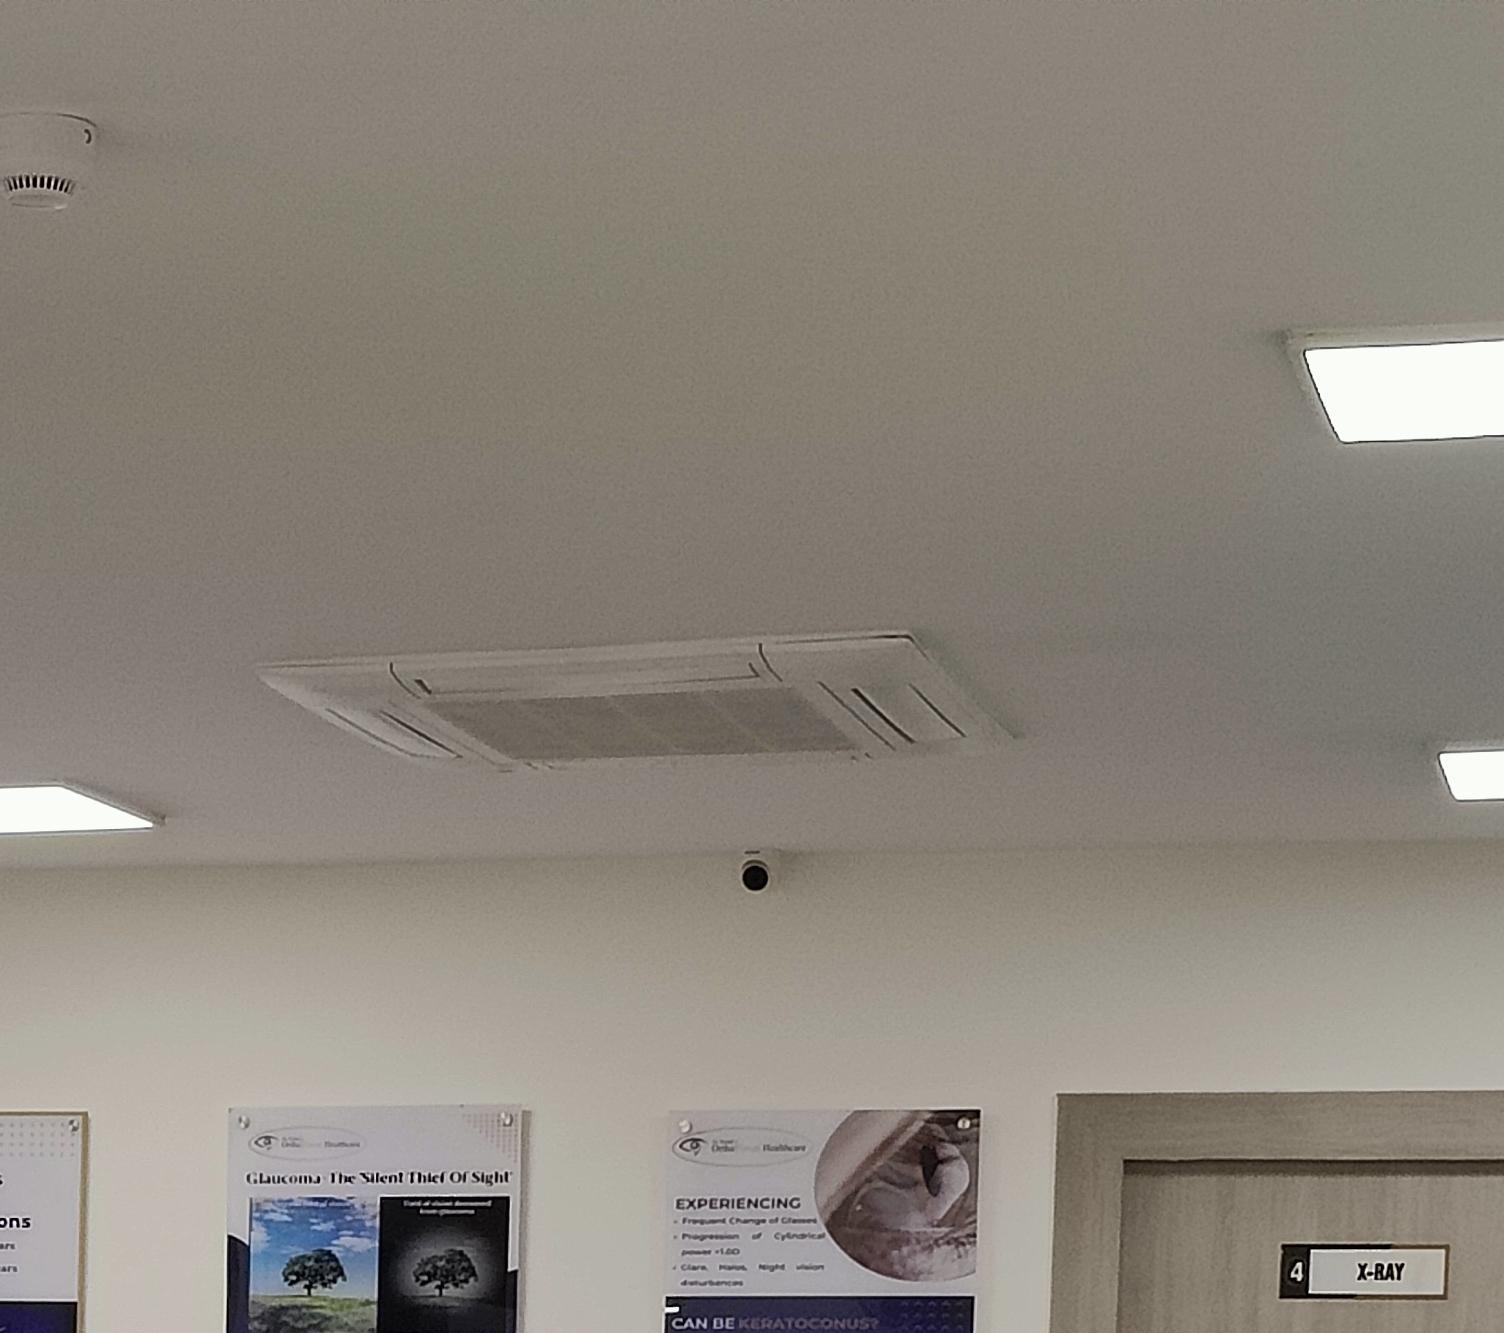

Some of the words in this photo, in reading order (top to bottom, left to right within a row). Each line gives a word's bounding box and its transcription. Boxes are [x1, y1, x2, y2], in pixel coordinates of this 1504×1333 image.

[331, 1172, 356, 1185] The
[409, 1171, 445, 1184] Thief
[450, 1171, 469, 1184] Of
[676, 1197, 801, 1210] EXPERIENCING
[682, 1217, 726, 1226] Frequent
[728, 1217, 767, 1226] Change
[681, 1233, 740, 1242] Progression
[751, 1232, 762, 1240] of
[774, 1232, 826, 1242] Cylindrical
[758, 1263, 785, 1272] Night
[1290, 1262, 1303, 1282] 4
[1357, 1263, 1405, 1281] X-RAY
[671, 1318, 708, 1330] CAN
[713, 1318, 735, 1330] BE
[739, 1318, 880, 1330] KERATOCONUS?
